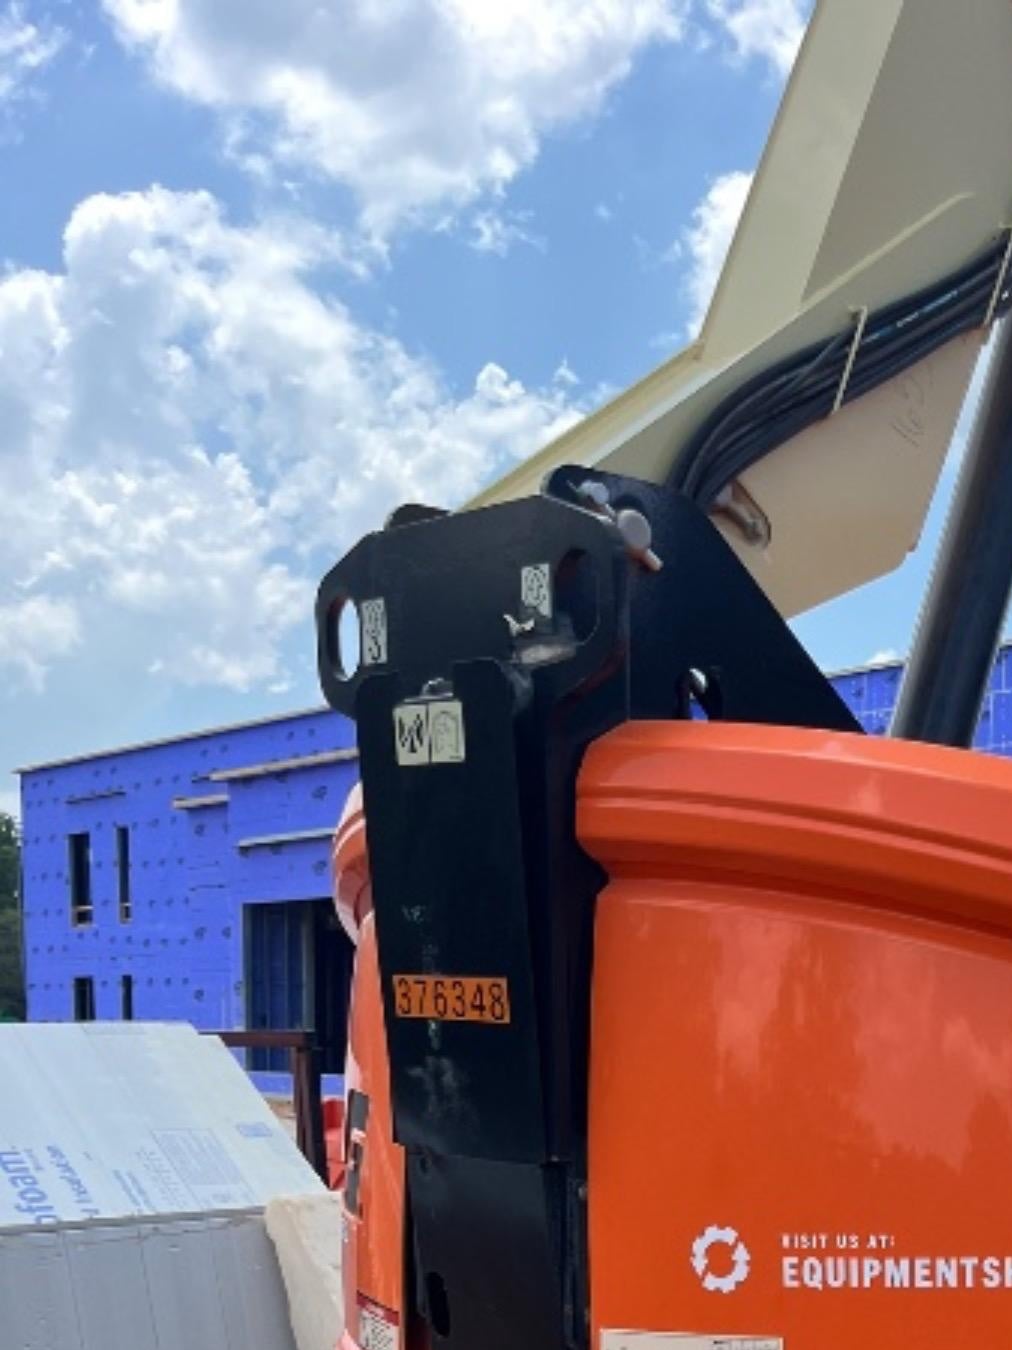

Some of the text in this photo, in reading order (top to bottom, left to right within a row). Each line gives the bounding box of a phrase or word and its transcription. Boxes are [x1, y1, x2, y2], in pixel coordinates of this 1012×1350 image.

[397, 976, 506, 1021] 376348
[835, 1233, 859, 1249] US
[866, 1233, 896, 1249] AT:
